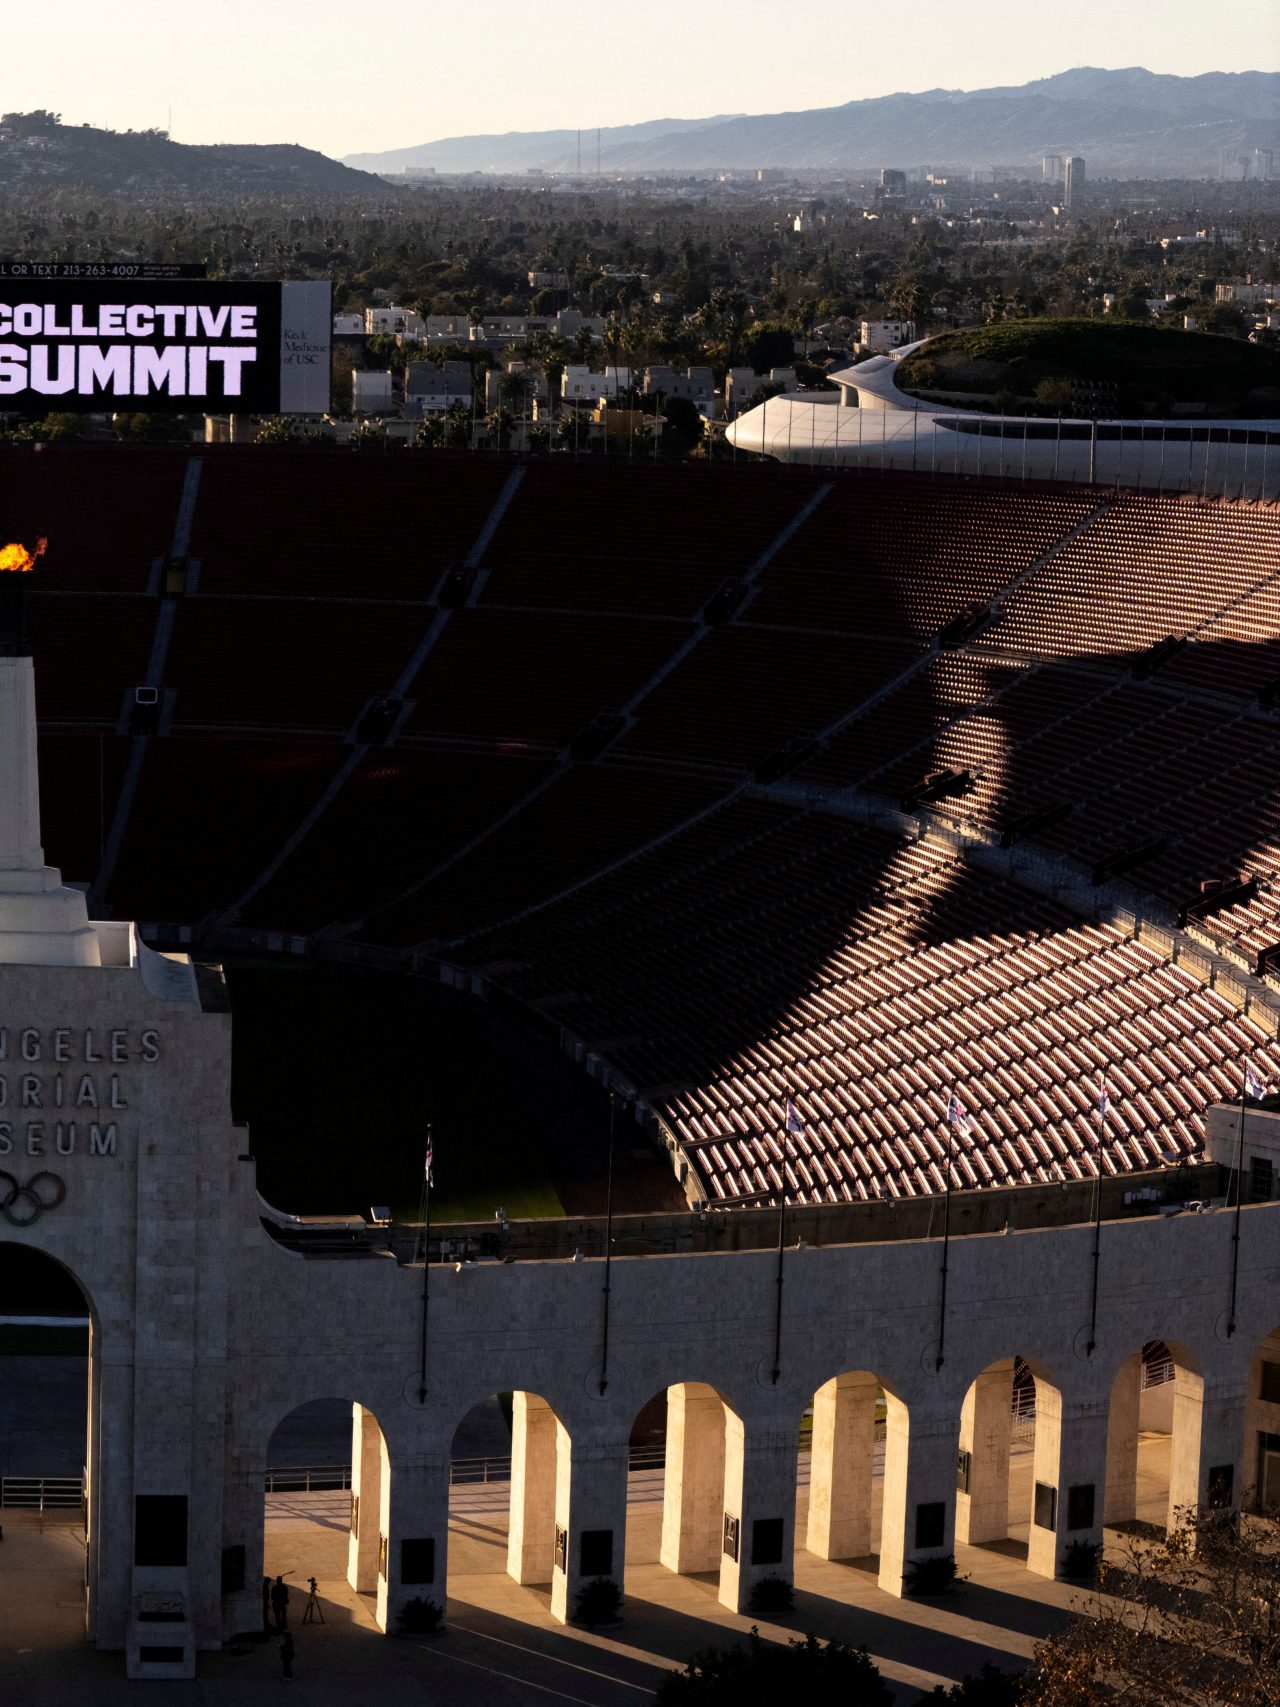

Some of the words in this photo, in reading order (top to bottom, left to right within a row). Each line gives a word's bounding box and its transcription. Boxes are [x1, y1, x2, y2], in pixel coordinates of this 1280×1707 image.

[11, 264, 28, 275] OR
[32, 265, 59, 275] TEXT
[63, 265, 140, 276] 213-263-4007
[284, 329, 307, 340] Keck
[283, 341, 328, 352] Medicine
[283, 353, 295, 364] of
[296, 354, 319, 365] USC
